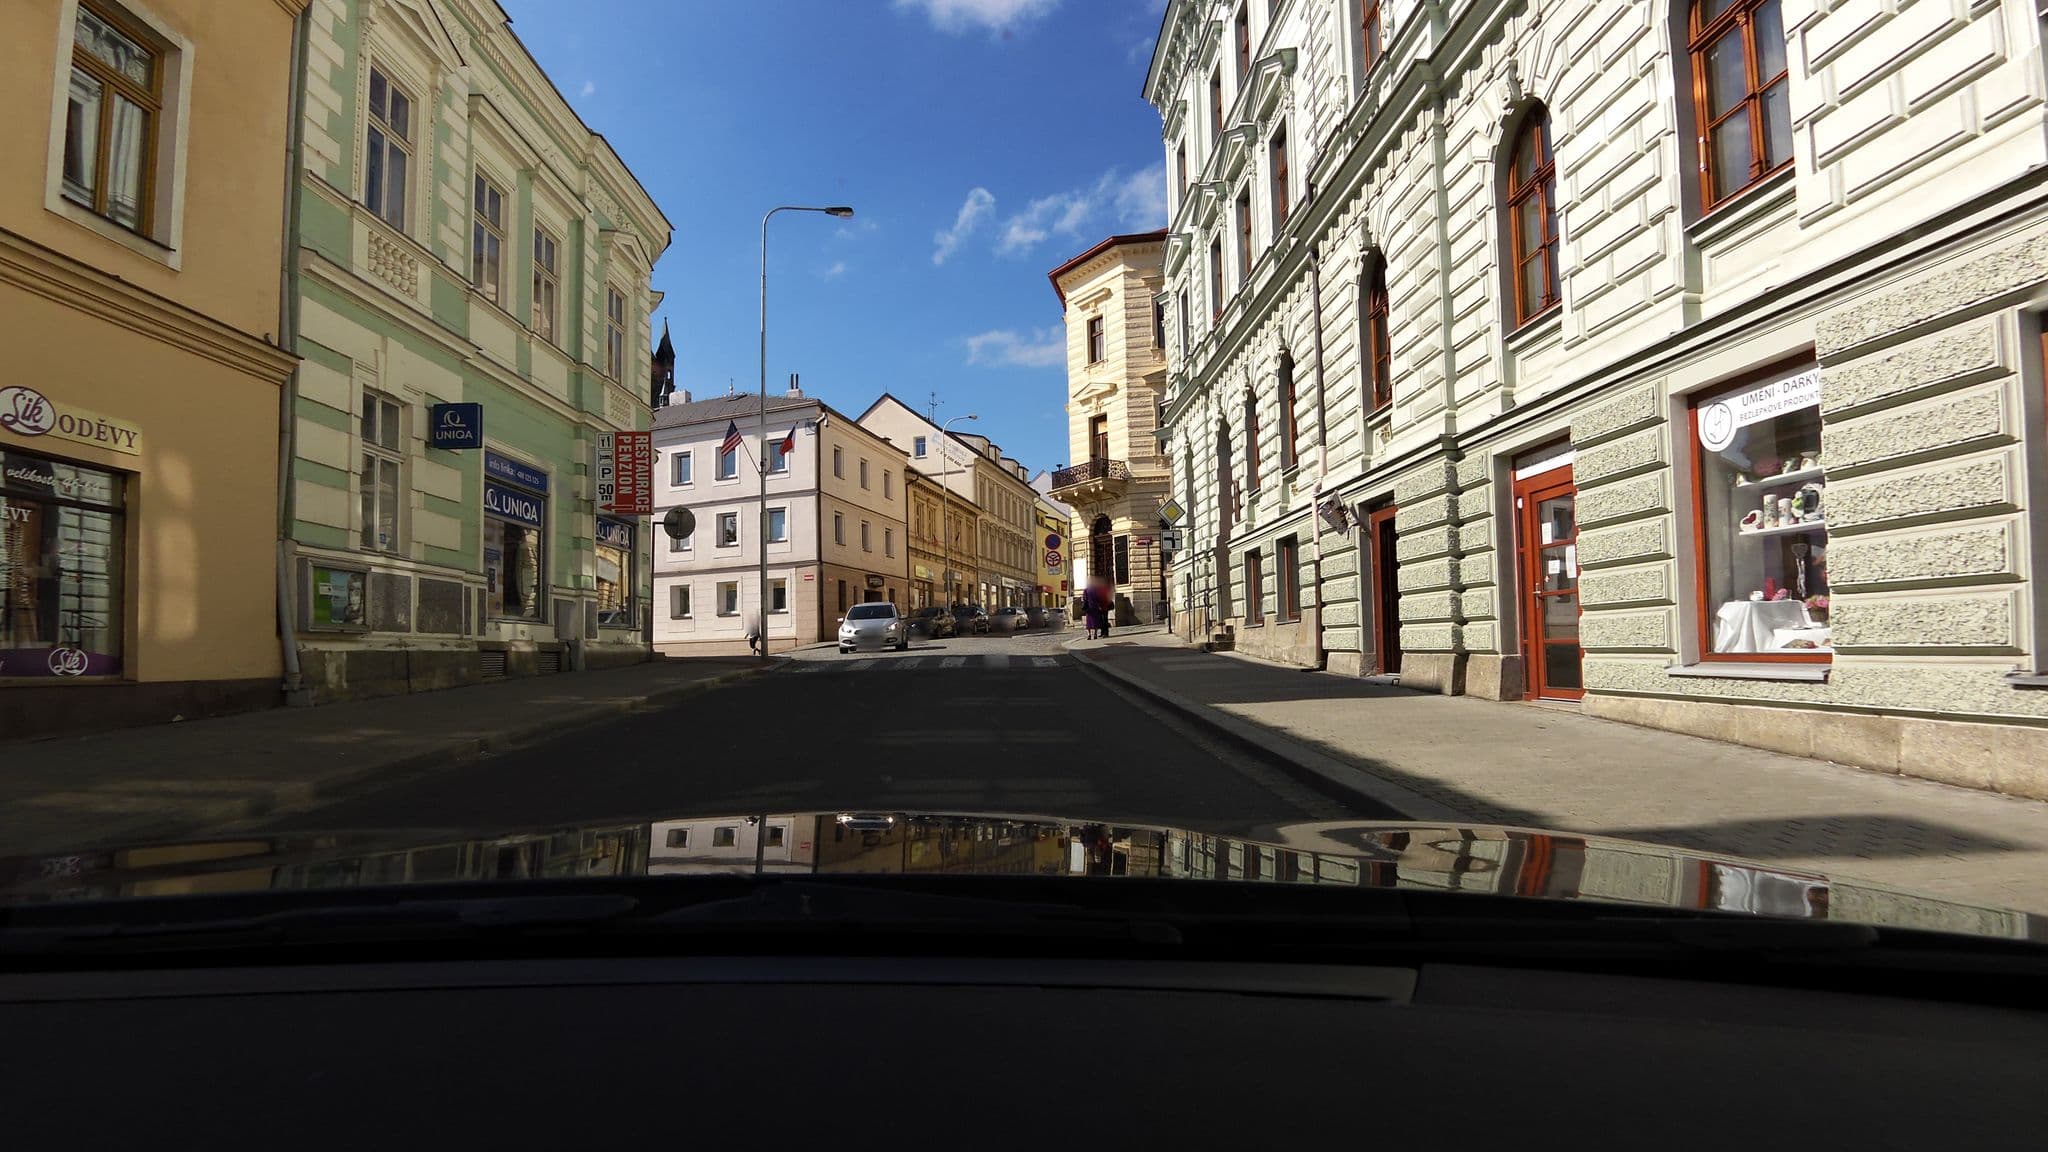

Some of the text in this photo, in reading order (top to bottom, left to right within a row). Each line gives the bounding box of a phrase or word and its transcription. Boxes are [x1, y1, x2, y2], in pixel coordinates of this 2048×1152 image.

[58, 414, 138, 448] ODĚVY
[435, 430, 473, 440] UNIQA
[601, 467, 612, 478] P
[618, 435, 633, 494] PENZION
[635, 435, 650, 512] RESTAURACE
[598, 484, 614, 495] 50
[0, 503, 32, 522] ĚVY
[502, 495, 538, 522] UNIQA
[606, 525, 630, 546] UNIQA
